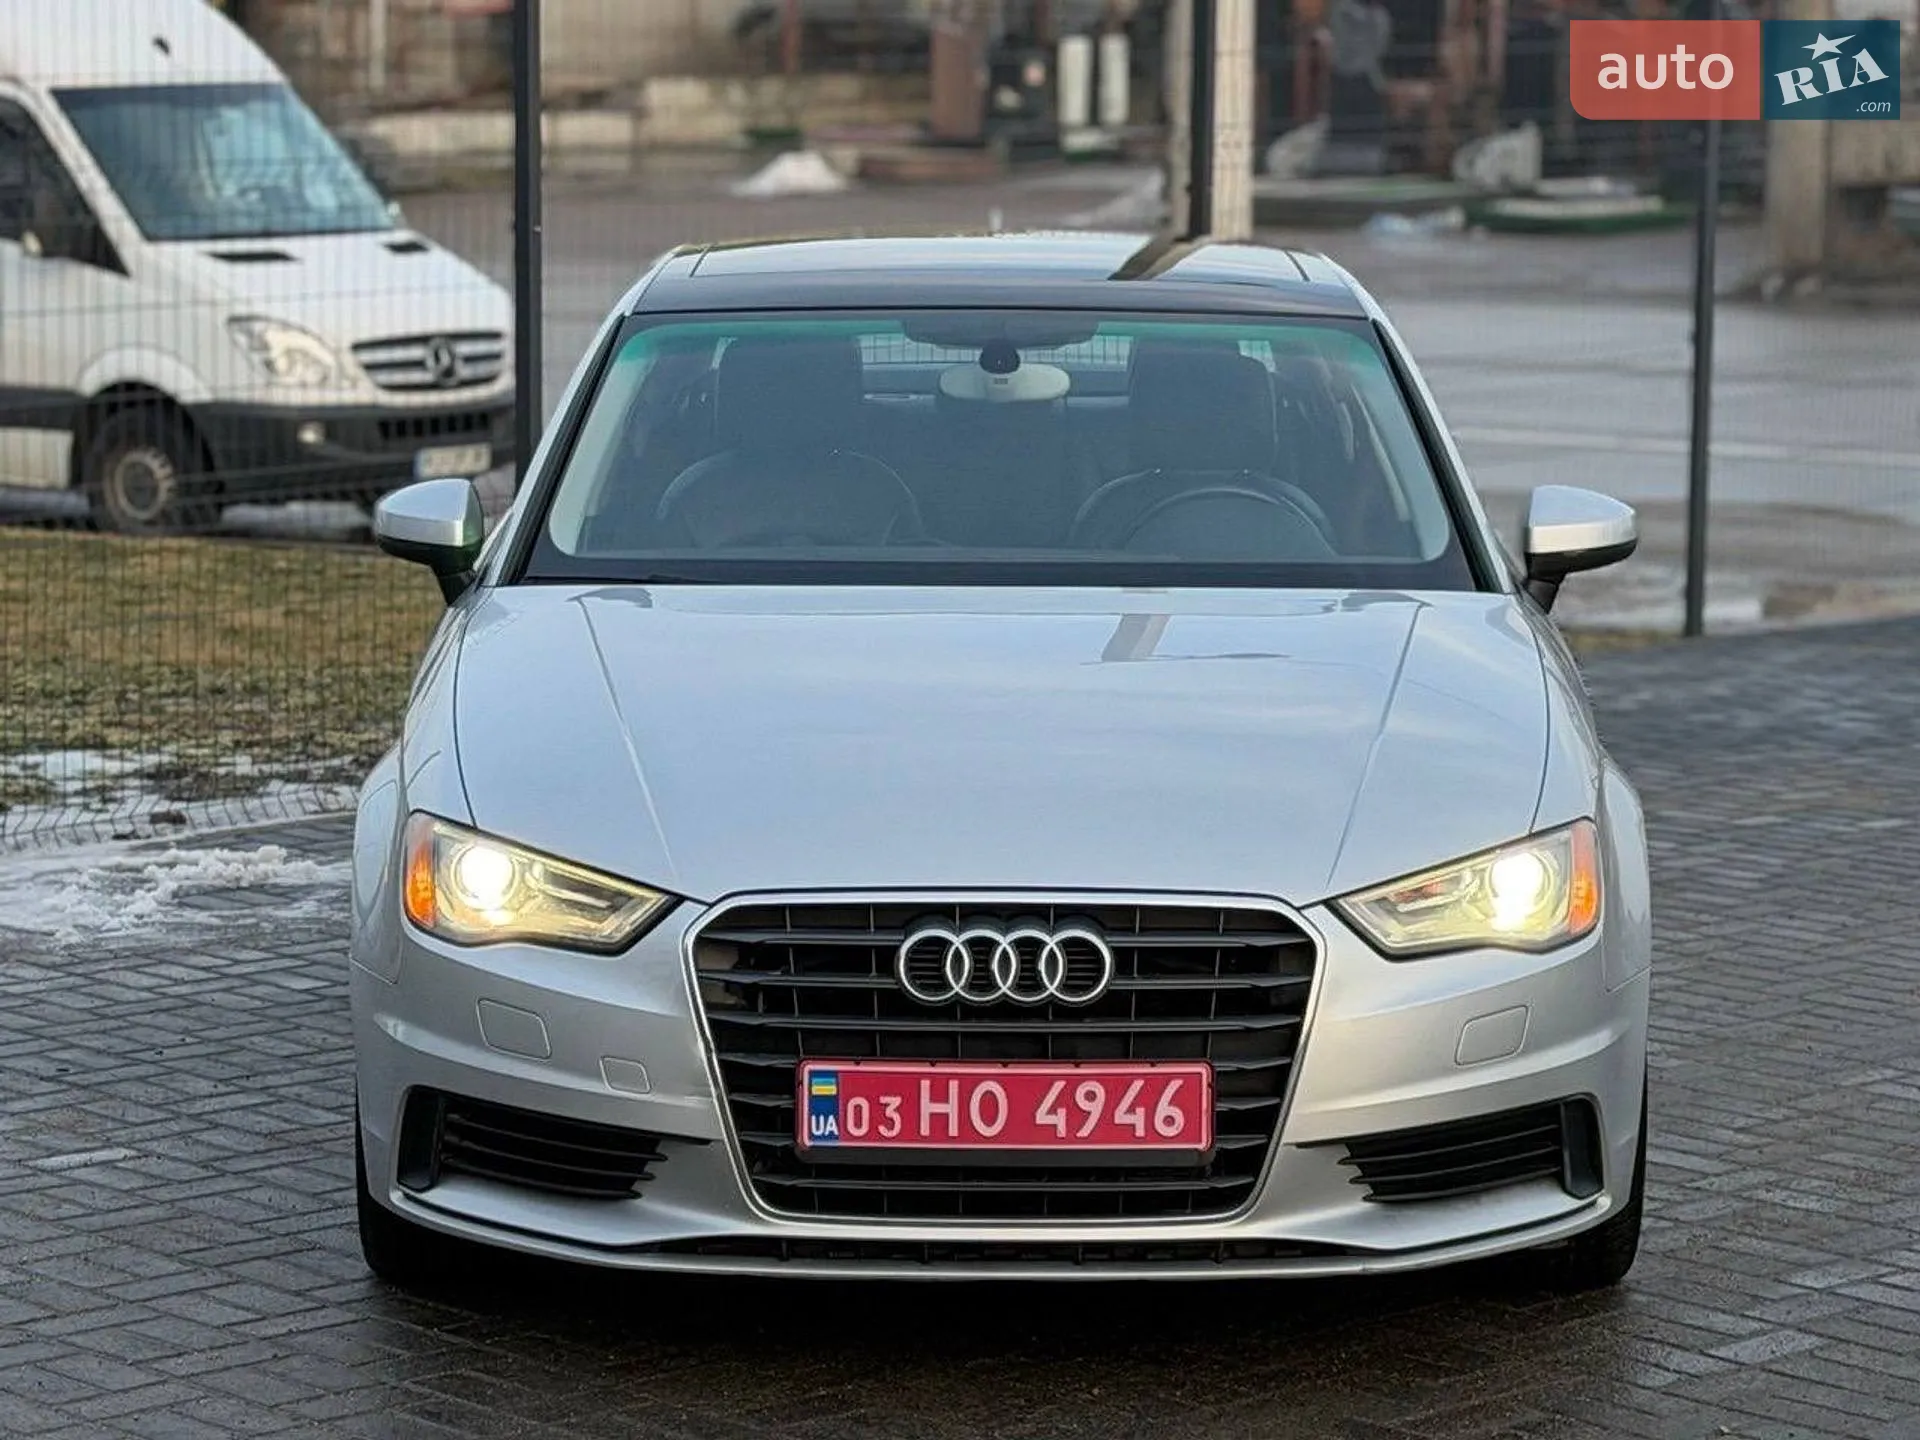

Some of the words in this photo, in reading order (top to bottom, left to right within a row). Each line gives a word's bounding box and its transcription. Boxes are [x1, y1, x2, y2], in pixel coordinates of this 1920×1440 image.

[811, 1114, 839, 1136] UA
[846, 1096, 902, 1137] 03
[919, 1079, 1009, 1137] HO
[1035, 1079, 1184, 1138] 4946
